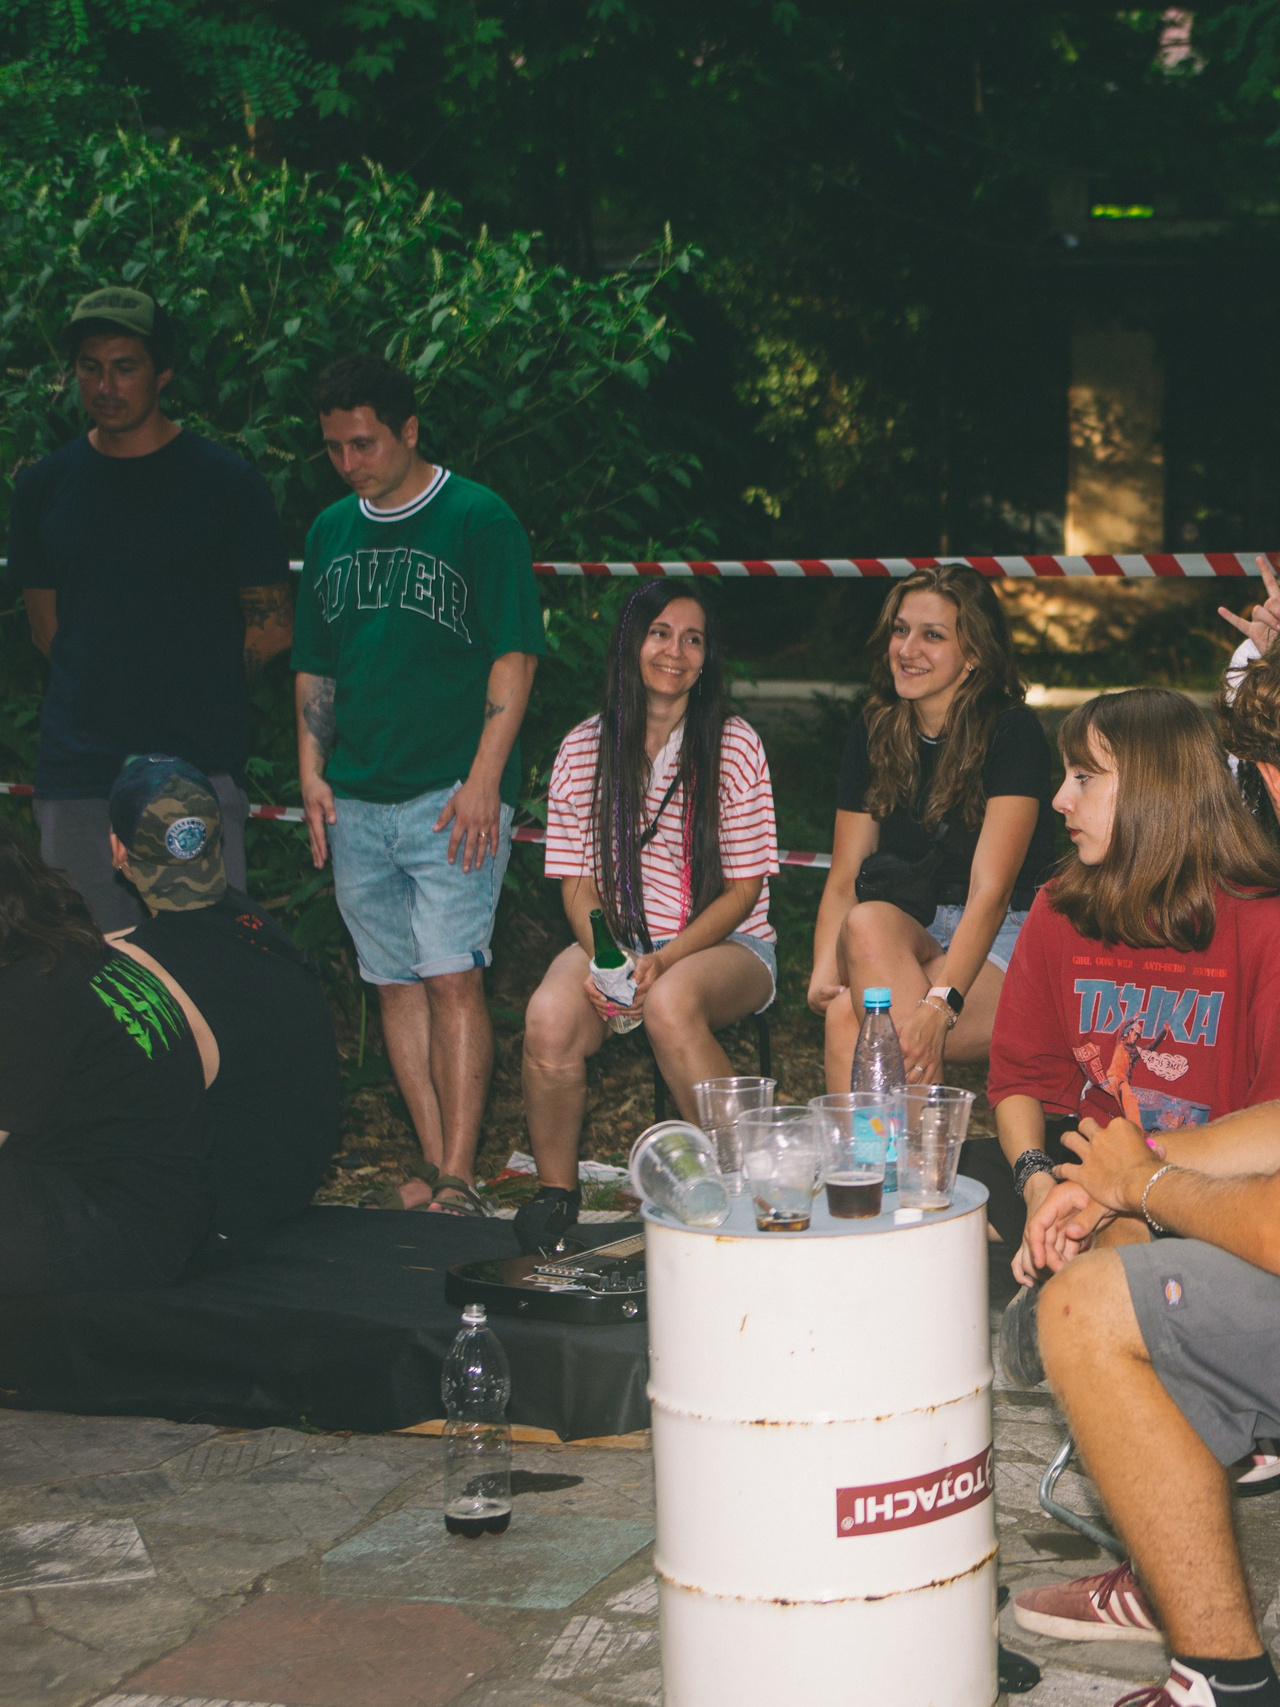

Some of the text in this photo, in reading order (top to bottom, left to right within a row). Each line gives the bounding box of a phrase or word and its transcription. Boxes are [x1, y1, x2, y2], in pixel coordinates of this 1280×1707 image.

[1072, 956, 1092, 966] GIRL
[1074, 978, 1225, 1047] TISHKA
[854, 1465, 985, 1525] TOTACHI
